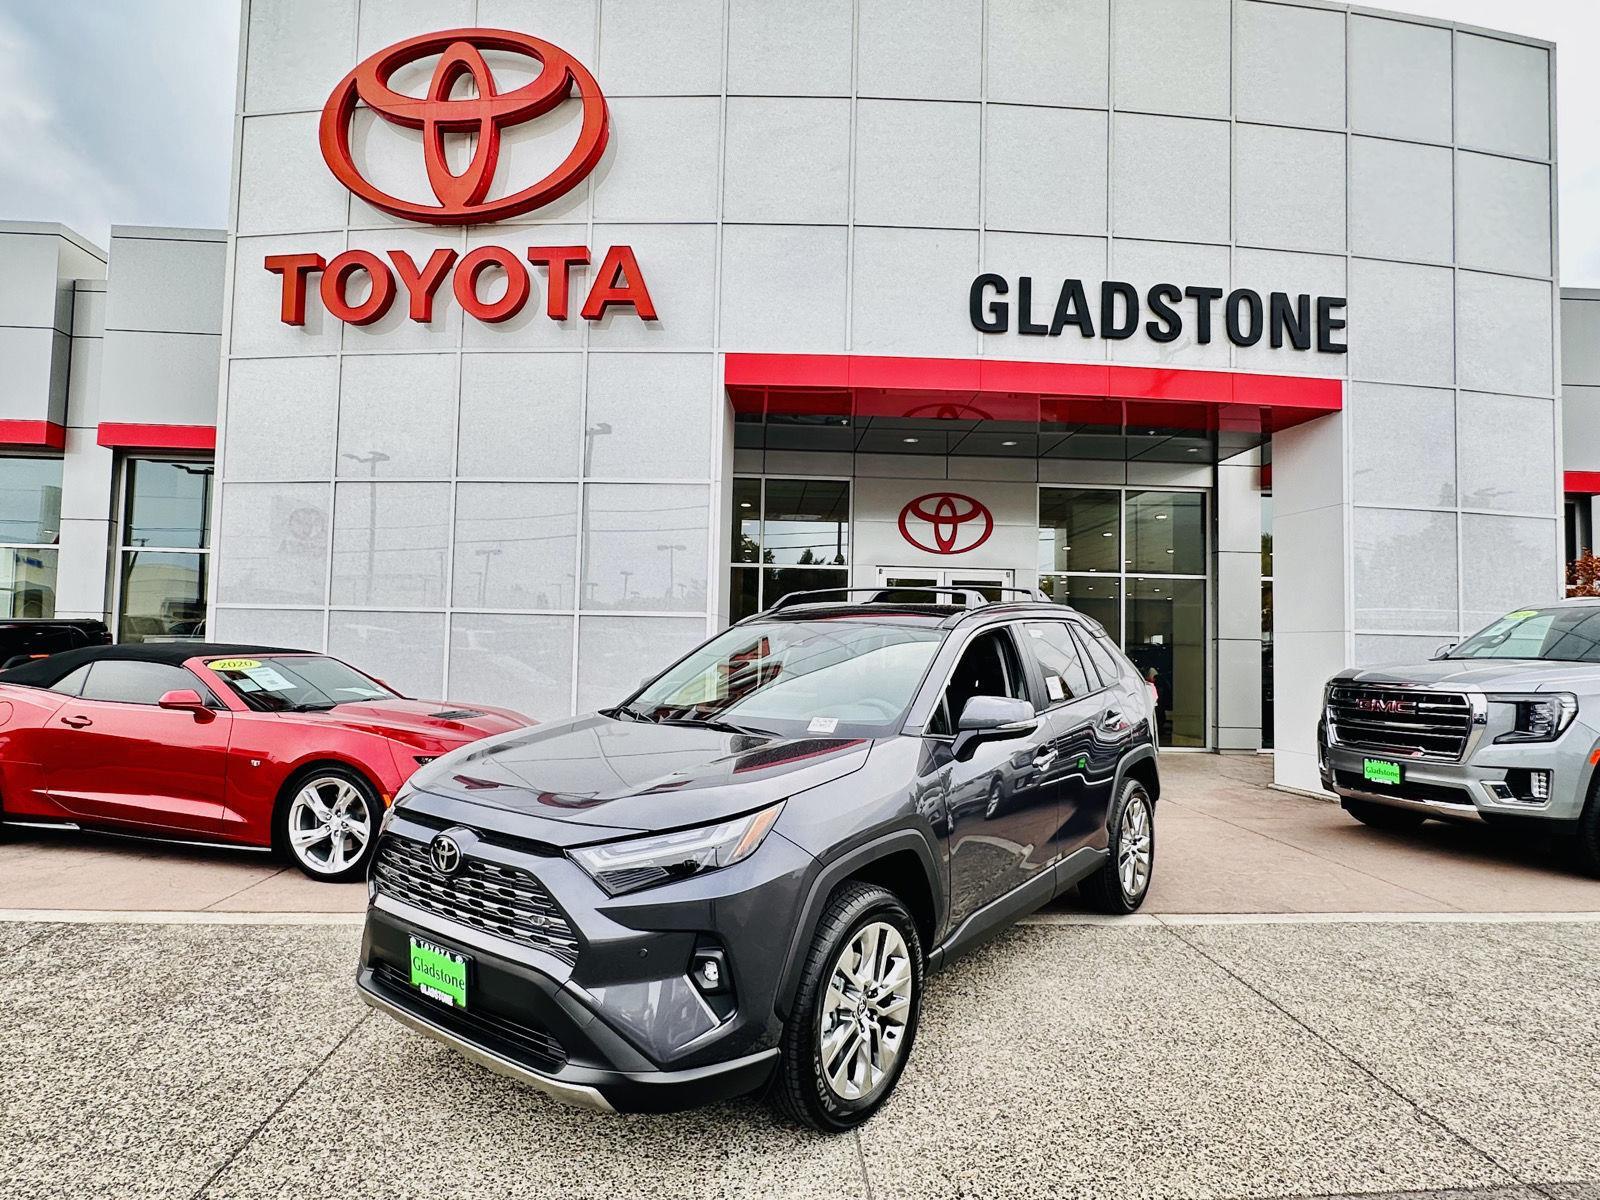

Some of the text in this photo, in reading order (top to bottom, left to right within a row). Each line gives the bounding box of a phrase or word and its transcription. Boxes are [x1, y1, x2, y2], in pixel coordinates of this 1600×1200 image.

[264, 245, 659, 326] TOYOTA
[969, 273, 1348, 354] GLADSTONE
[219, 661, 253, 669] 2020
[1355, 698, 1417, 714] GMC
[1365, 766, 1399, 778] Gladstone
[412, 956, 465, 991] Gladstone
